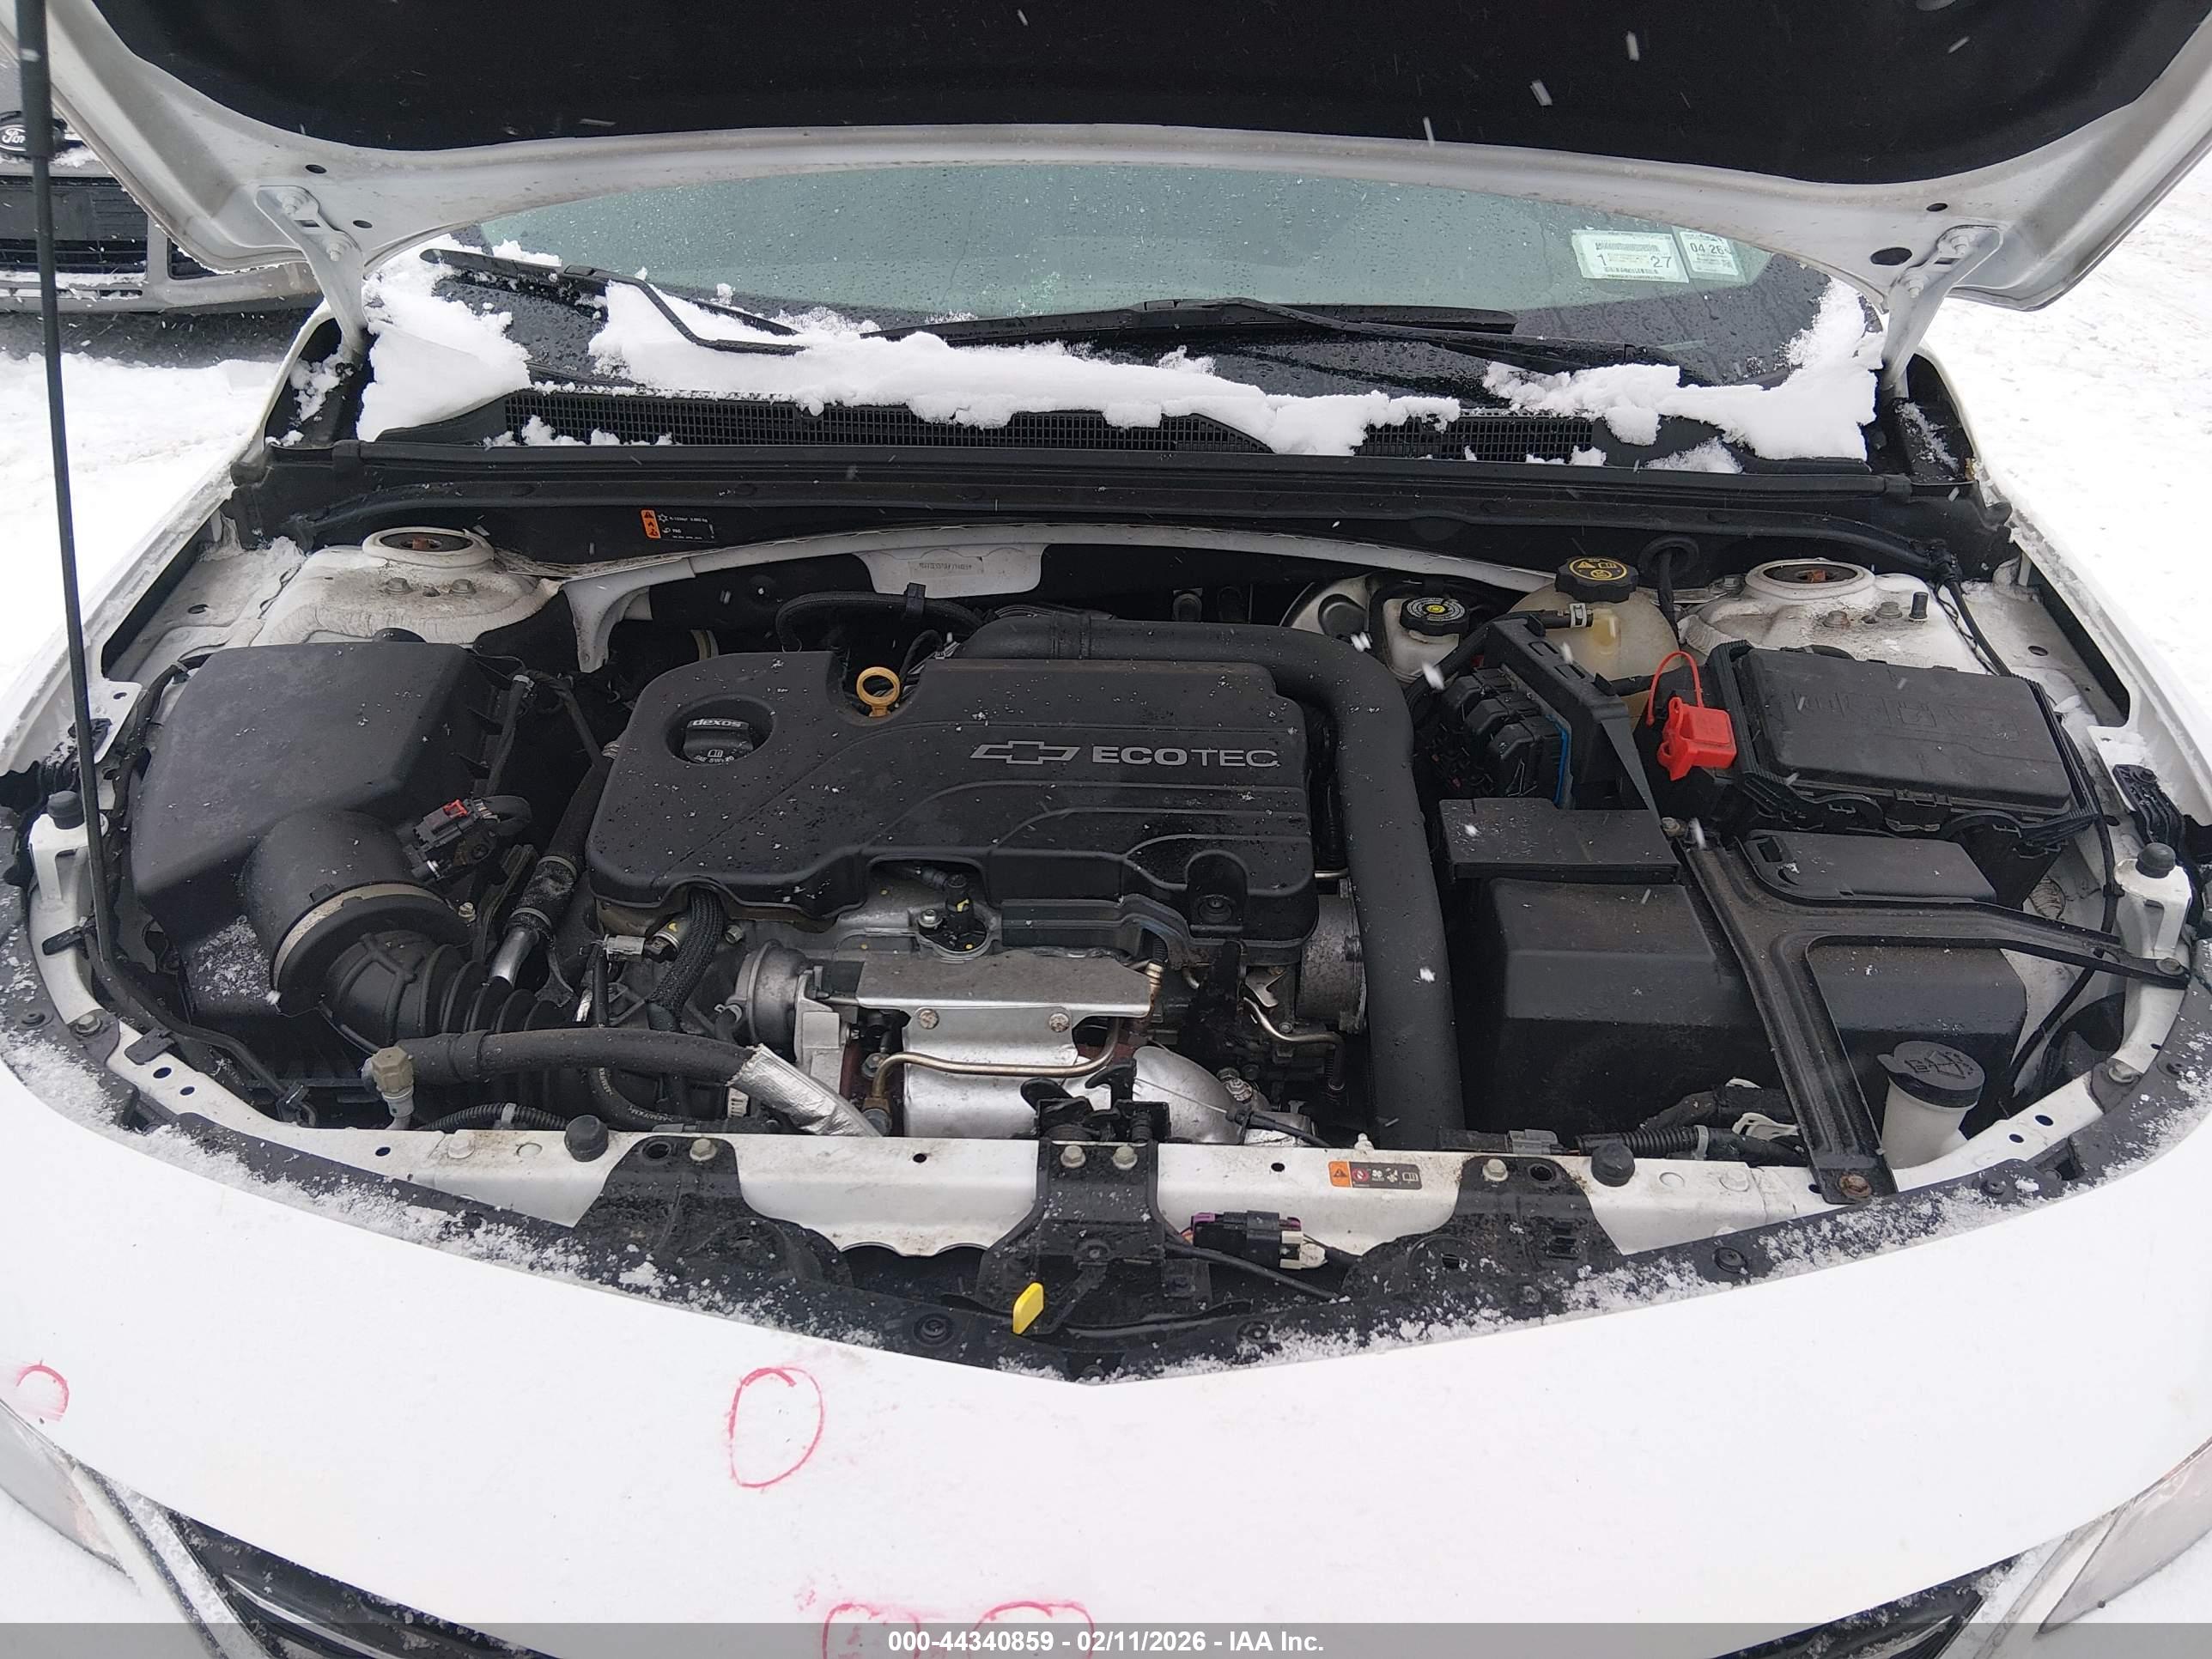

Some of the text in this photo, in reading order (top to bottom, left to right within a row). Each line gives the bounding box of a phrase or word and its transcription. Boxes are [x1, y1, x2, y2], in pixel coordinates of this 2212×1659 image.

[2, 128, 27, 143] For
[1689, 242, 1725, 255] 04 26
[1596, 253, 1607, 266] 1
[1650, 255, 1672, 269] 27
[692, 718, 742, 727] dexos
[1091, 746, 1279, 766] ECOTEC
